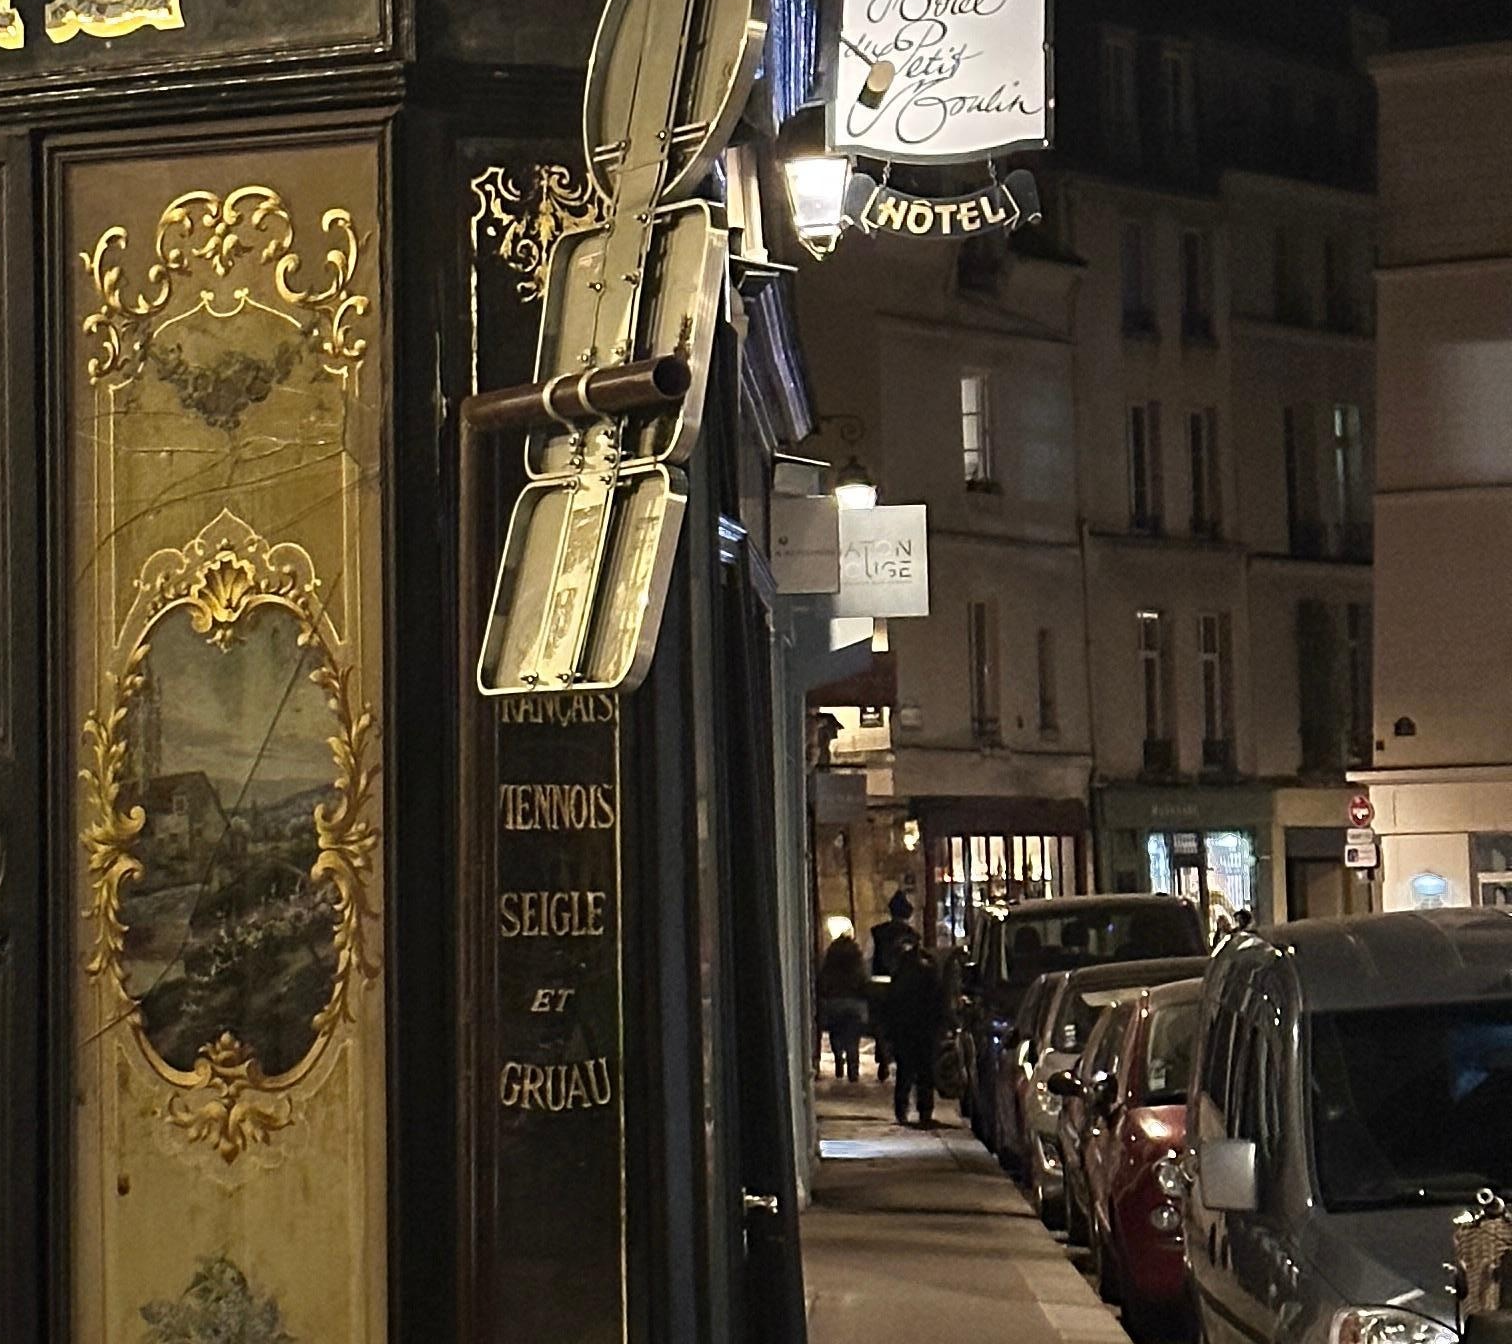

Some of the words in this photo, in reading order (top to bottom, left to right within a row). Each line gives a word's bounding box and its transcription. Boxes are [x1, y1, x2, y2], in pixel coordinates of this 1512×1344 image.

[877, 196, 1006, 235] HÔTEL
[842, 539, 912, 557] ATON
[500, 694, 615, 728] RANÇAIS
[500, 891, 607, 938] SEIGLE
[530, 988, 575, 1012] ET
[499, 1058, 613, 1112] GRUAU
